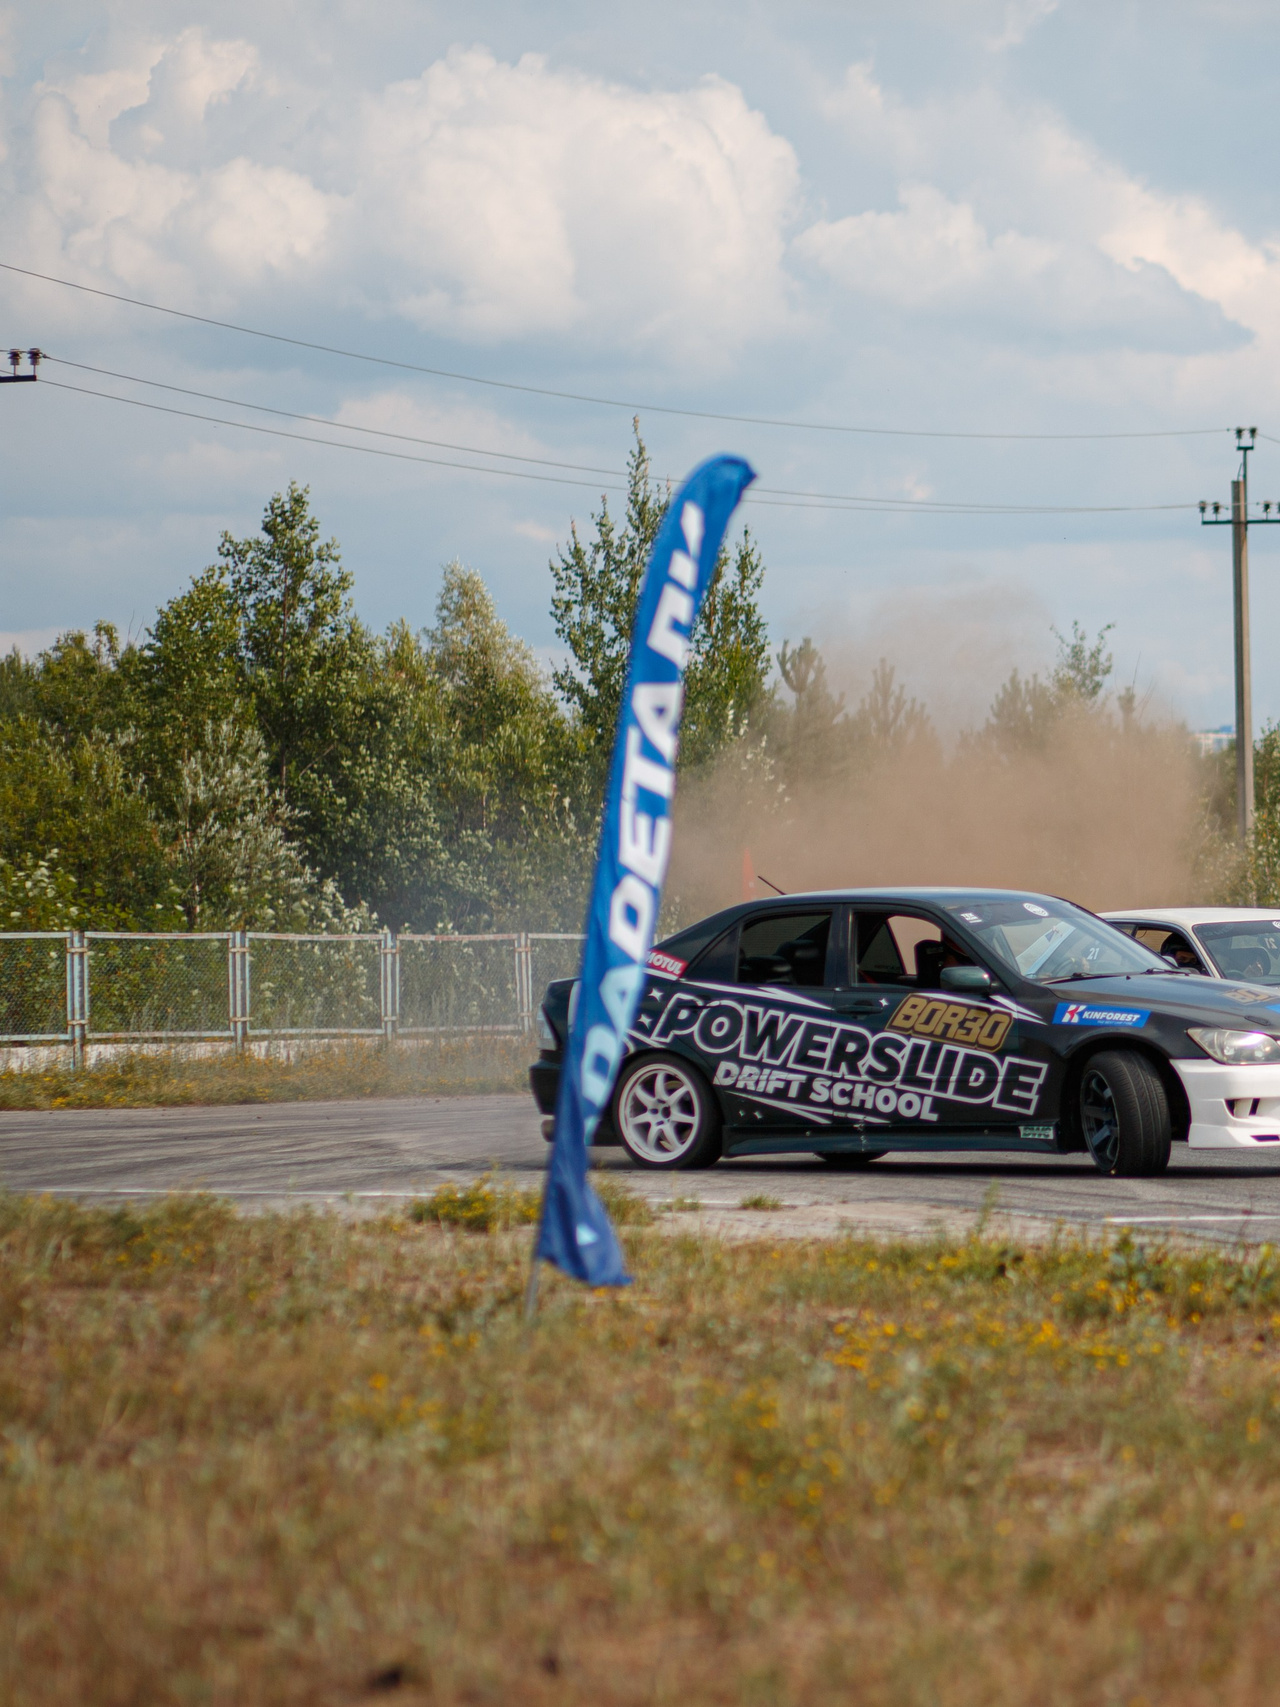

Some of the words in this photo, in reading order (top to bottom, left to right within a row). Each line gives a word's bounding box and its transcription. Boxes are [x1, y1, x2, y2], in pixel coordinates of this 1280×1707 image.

[1087, 947, 1100, 960] 21
[1082, 1011, 1141, 1022] KINFOREST
[651, 993, 1047, 1115] POWERSLIDE
[713, 1060, 807, 1098] DRIFT
[809, 1077, 938, 1121] SCHOOL
